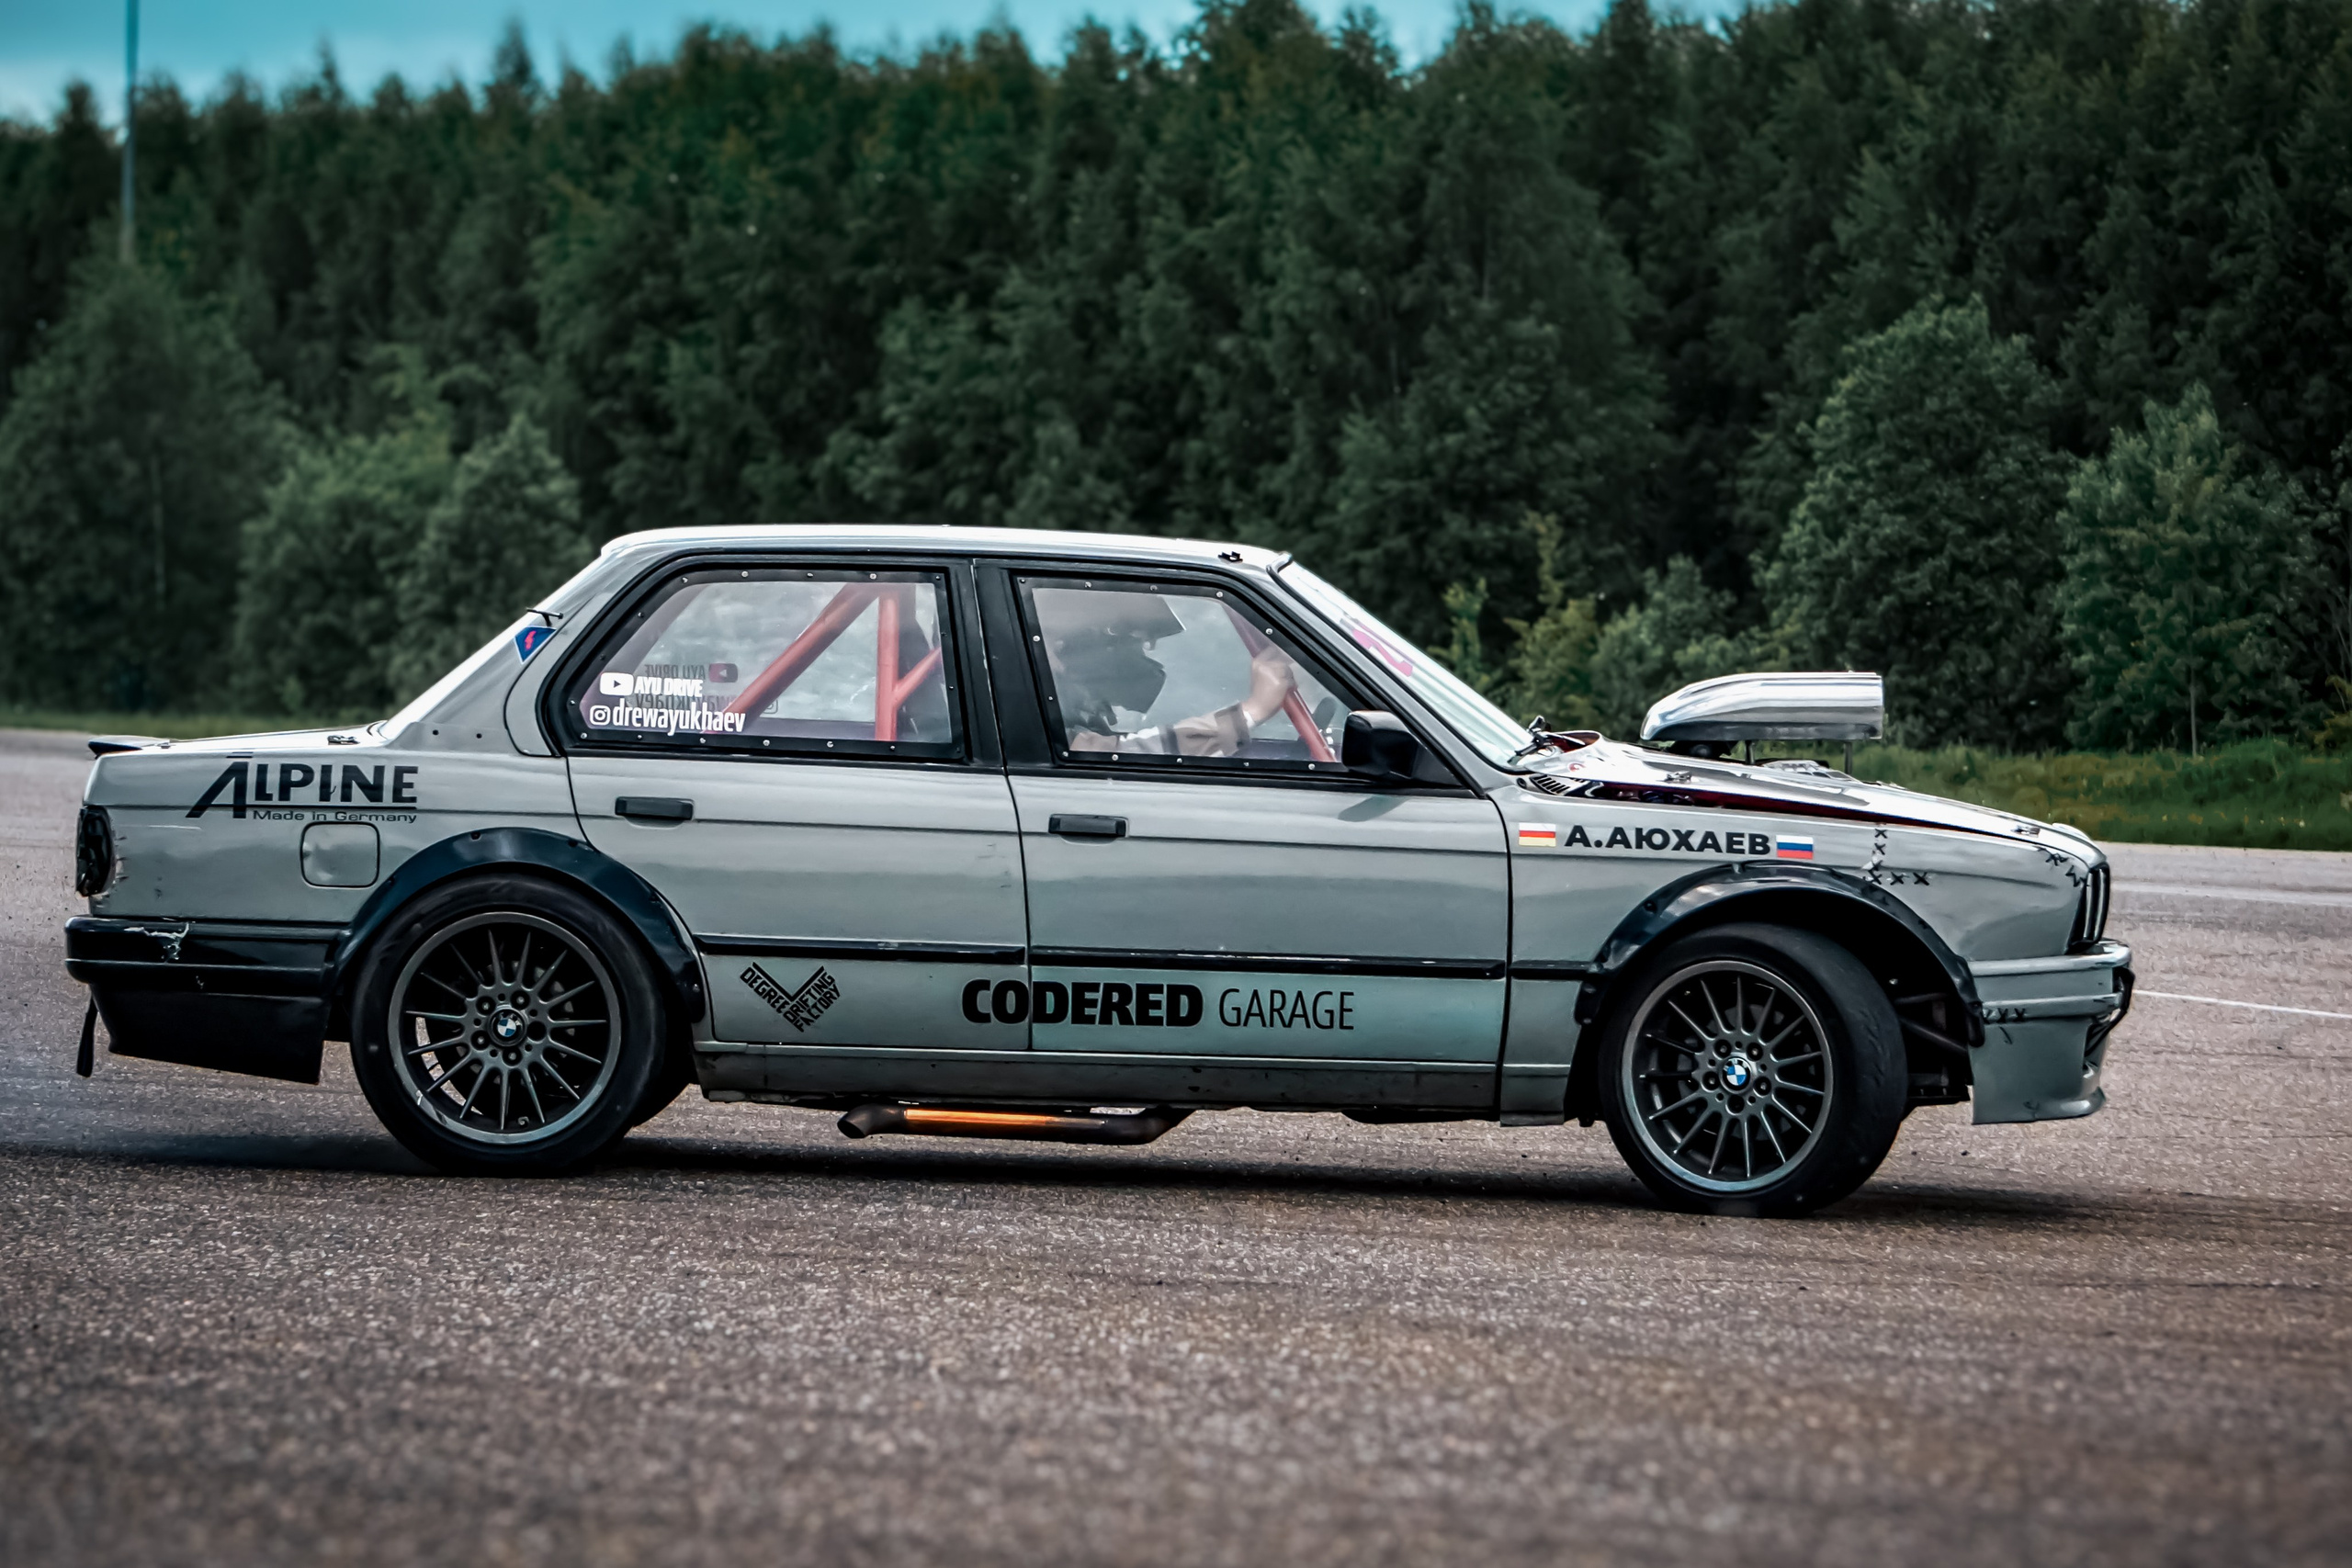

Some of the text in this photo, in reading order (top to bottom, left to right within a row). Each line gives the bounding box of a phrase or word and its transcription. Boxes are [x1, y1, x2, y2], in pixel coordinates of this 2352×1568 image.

[634, 676, 703, 697] AYU DRIVE
[613, 698, 746, 736] drewayukhaev
[185, 761, 418, 818] ALPINE
[253, 810, 417, 824] Made in Germany
[1564, 825, 1771, 856] А.АЮХАЕВ
[740, 966, 790, 1013] DEGREE
[783, 972, 835, 1023] DRIFTING
[793, 983, 841, 1032] FACTORY
[961, 978, 1354, 1030] CODERED GARAGE
